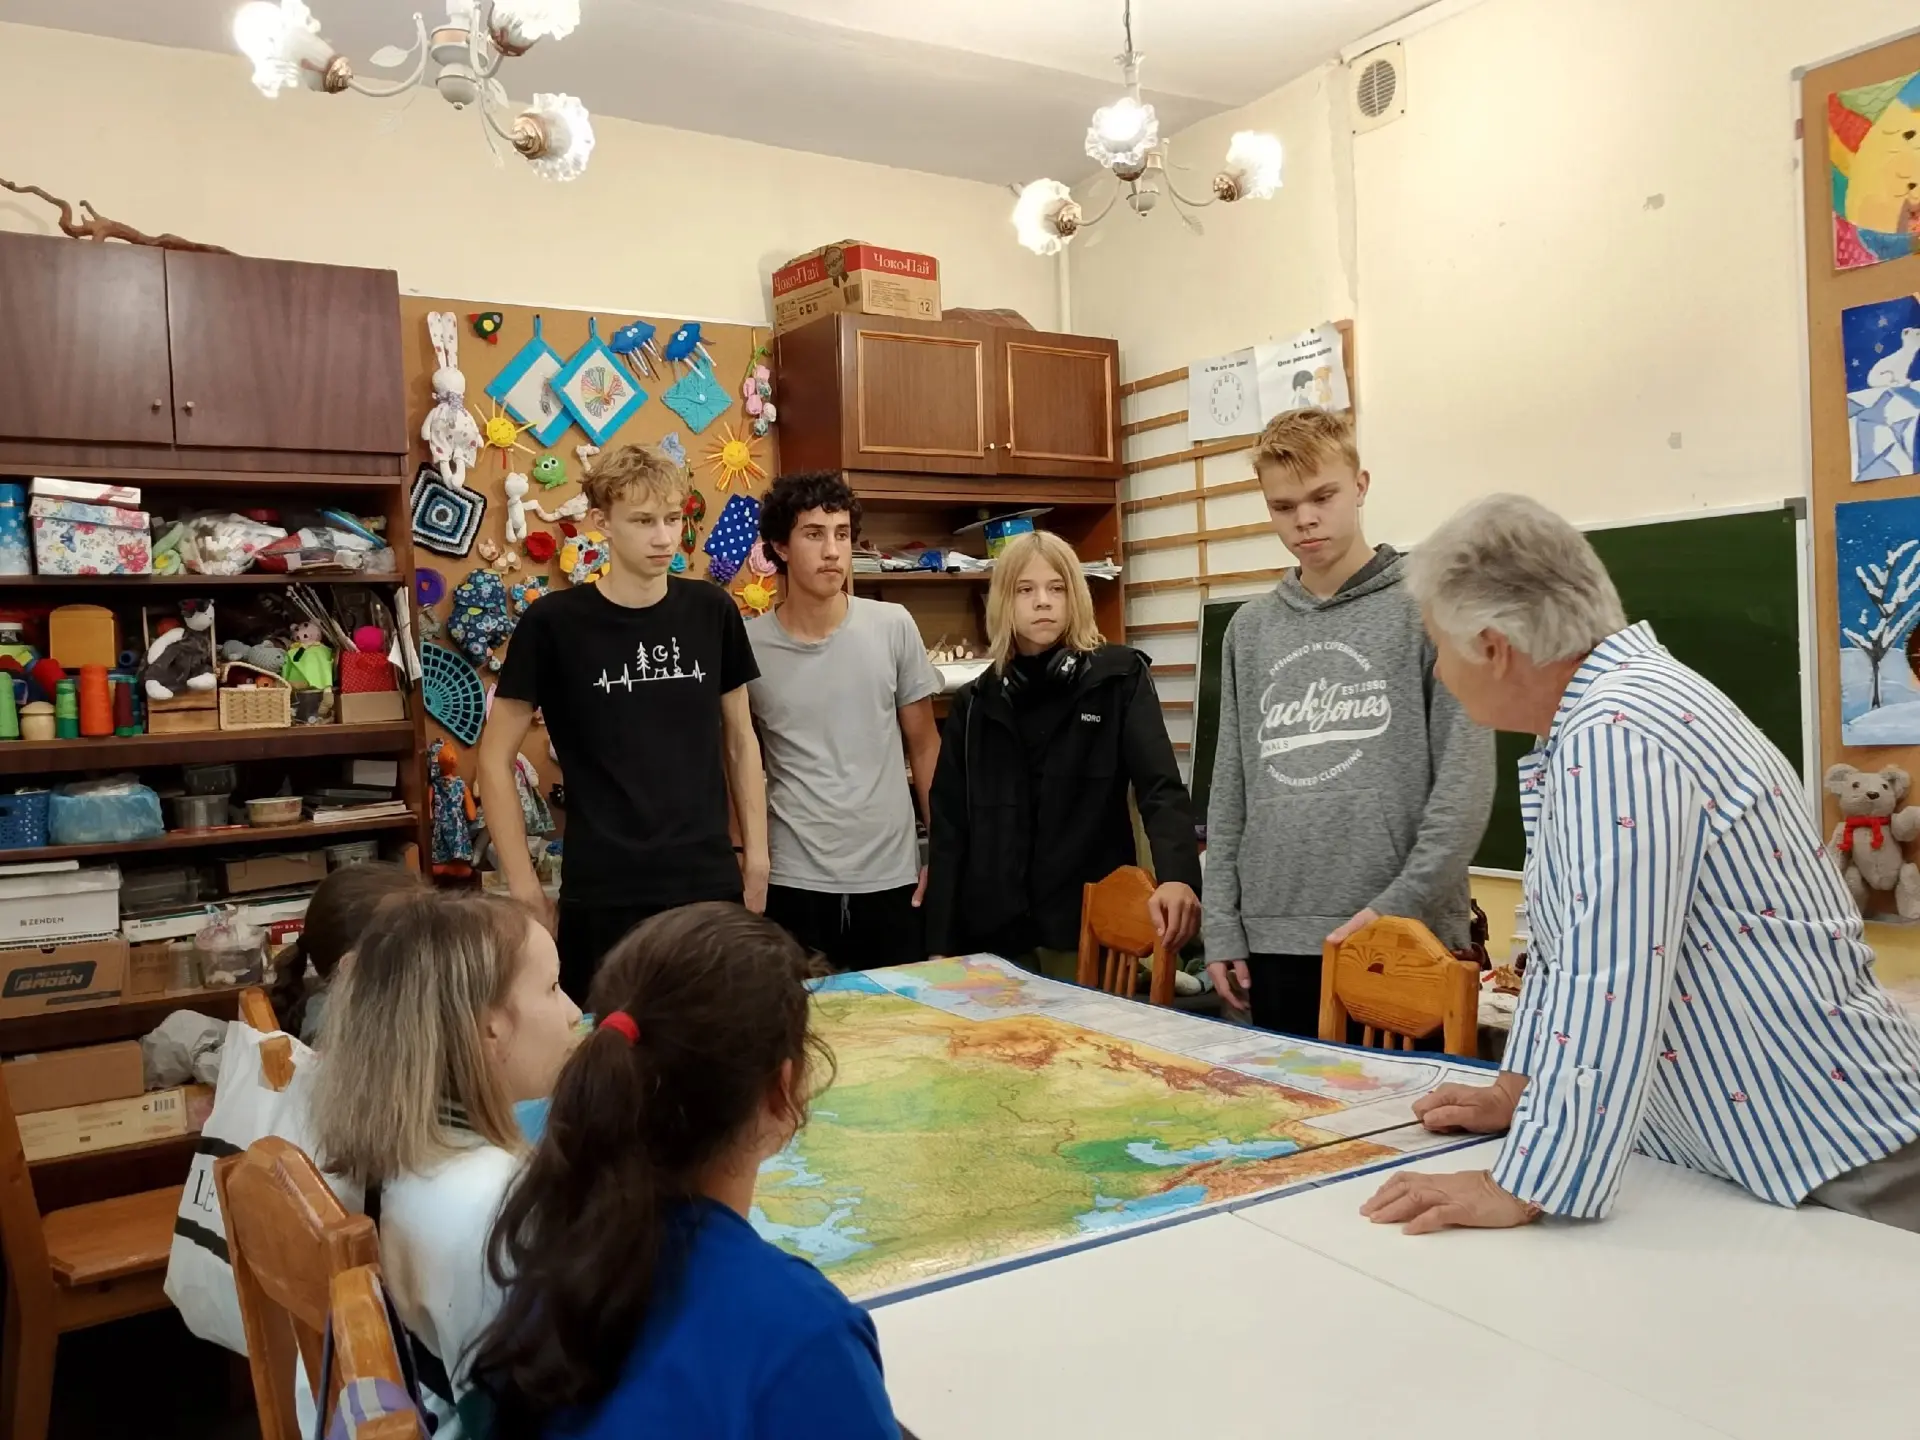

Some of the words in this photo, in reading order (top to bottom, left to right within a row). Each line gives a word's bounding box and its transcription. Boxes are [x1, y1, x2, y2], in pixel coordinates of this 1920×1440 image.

[873, 252, 930, 275] Чоко-Пай
[774, 262, 820, 292] Чоко-Пай
[920, 301, 931, 312] 12
[1309, 682, 1391, 733] Jones
[1320, 749, 1364, 781] CLOTHING
[28, 917, 65, 926] ZENDEN
